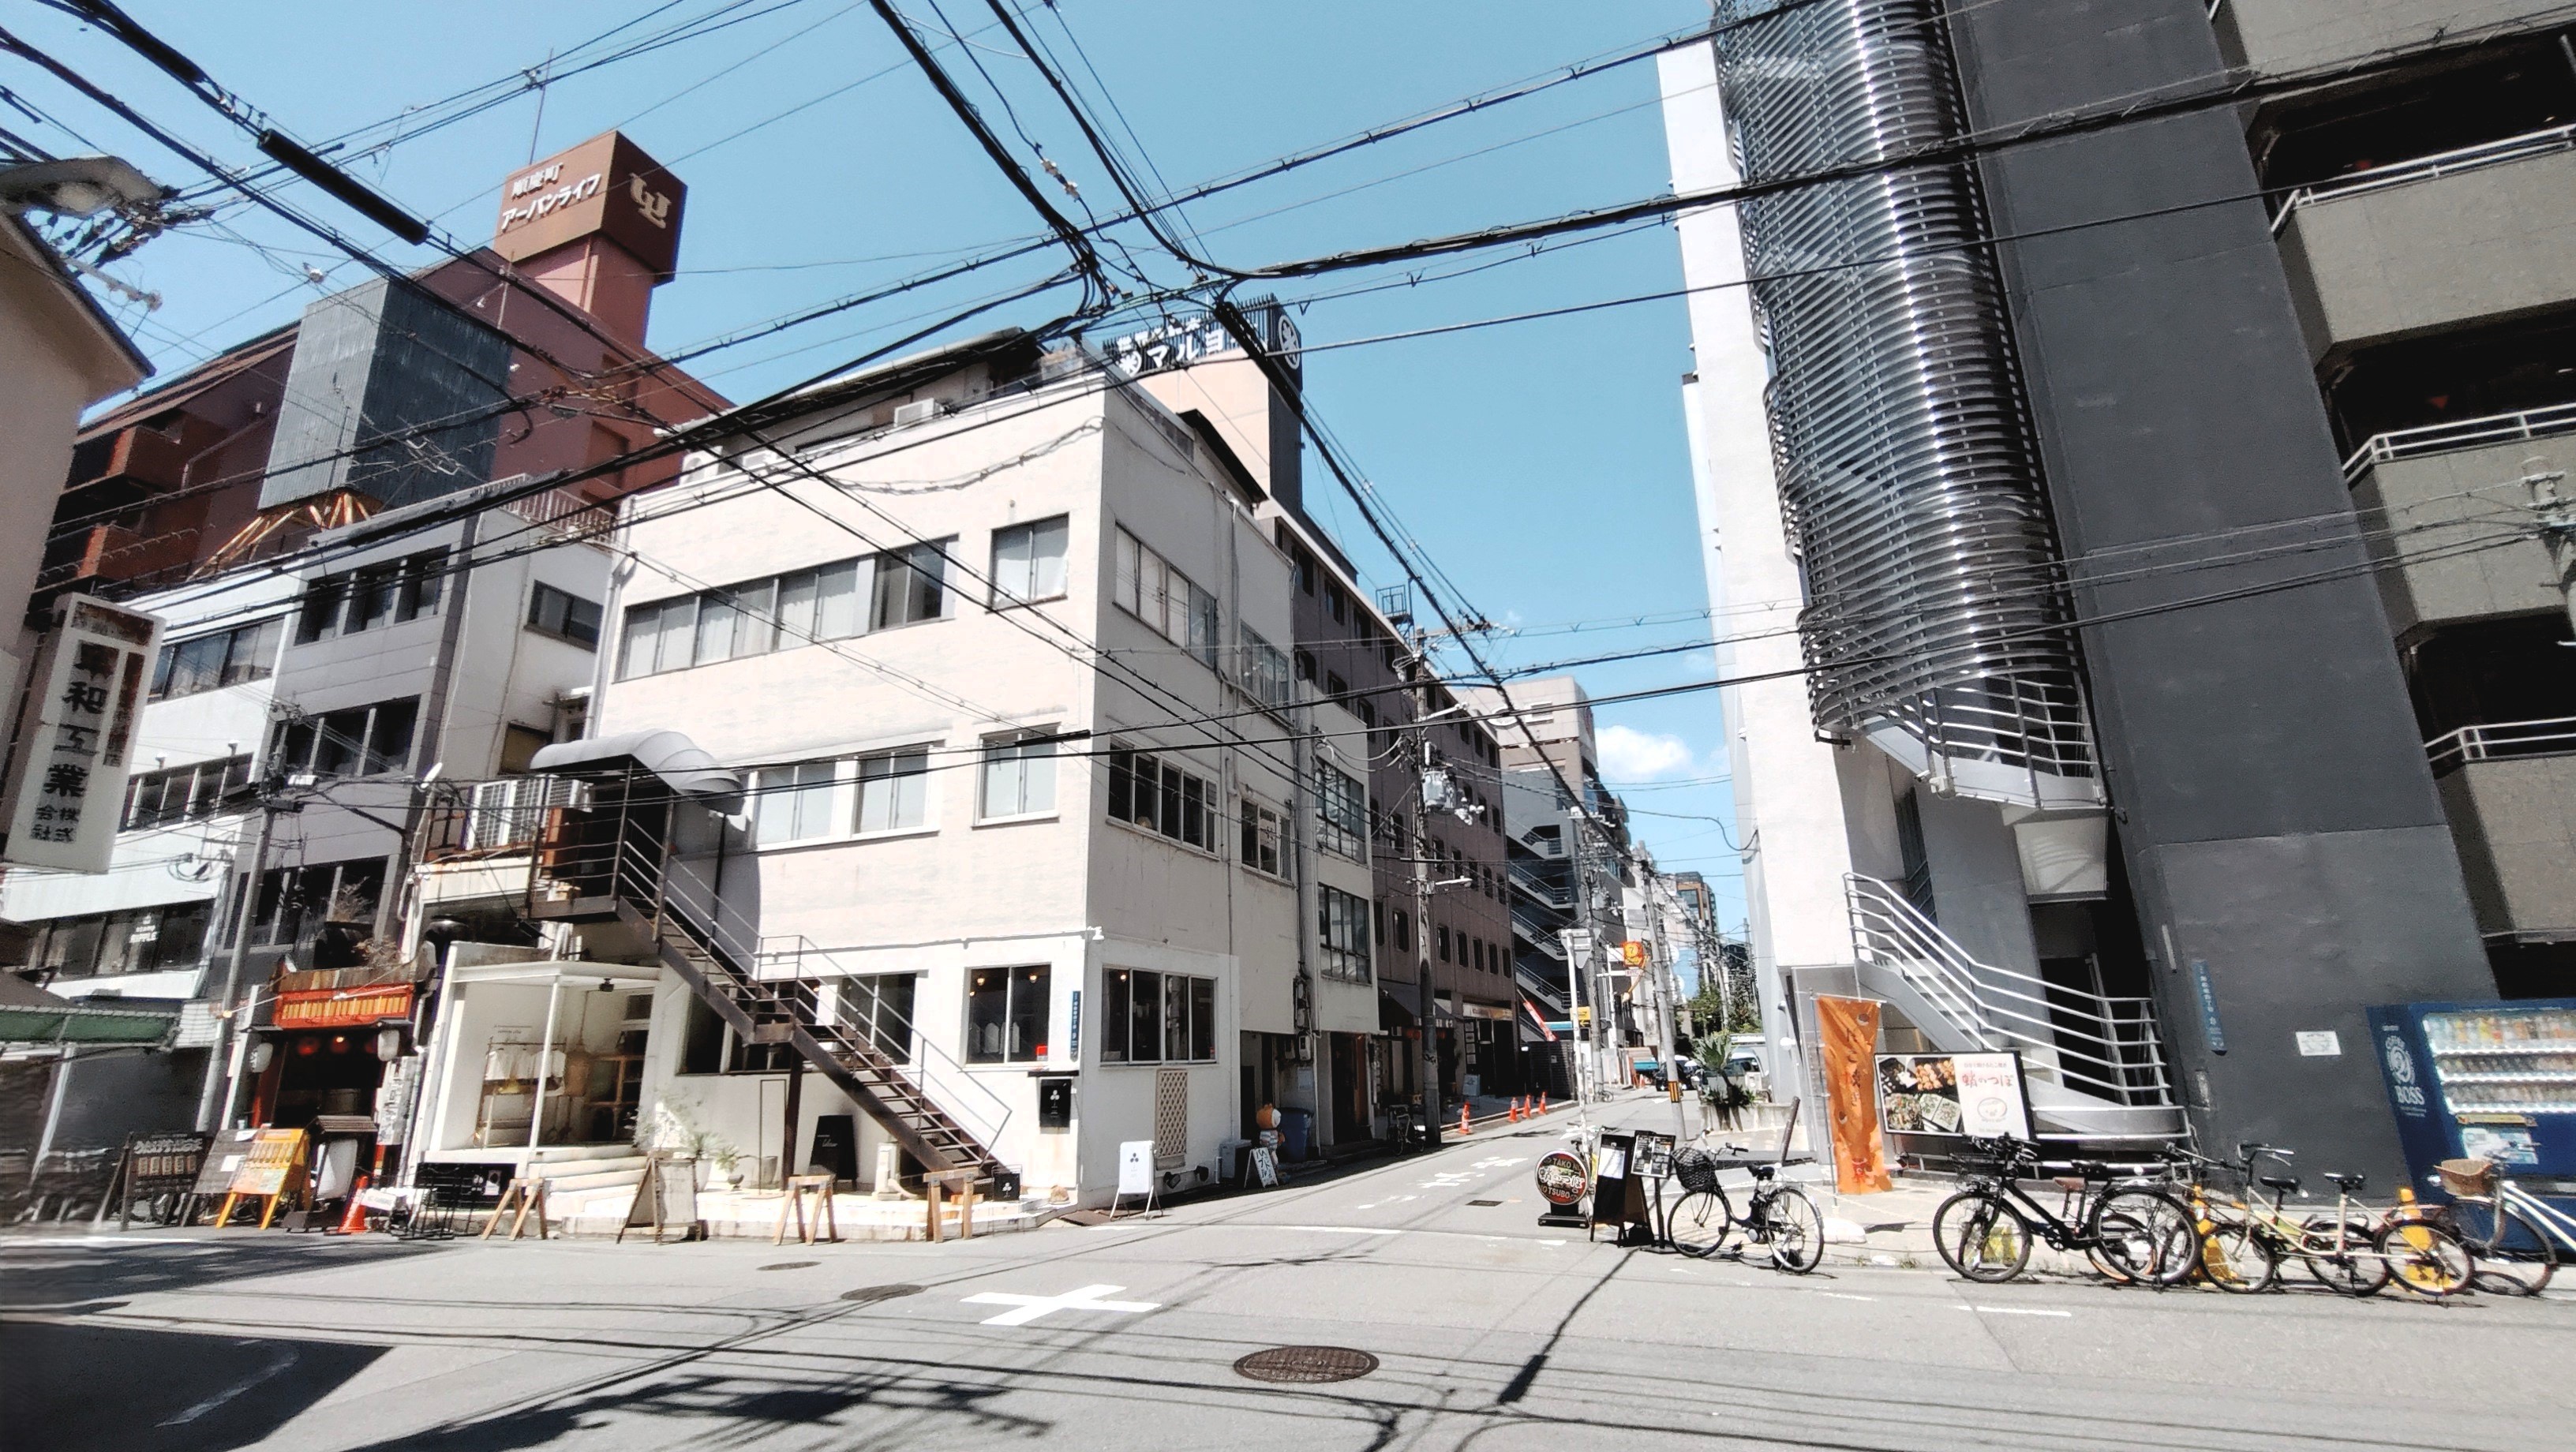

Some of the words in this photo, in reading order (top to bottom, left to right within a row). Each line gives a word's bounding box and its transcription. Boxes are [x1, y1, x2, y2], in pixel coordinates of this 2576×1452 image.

[501, 174, 601, 232] アーバンライフ
[2394, 1085, 2425, 1106] BOSS
[1552, 1158, 1571, 1169] TAKO
[1548, 1187, 1571, 1199] TSUBO
